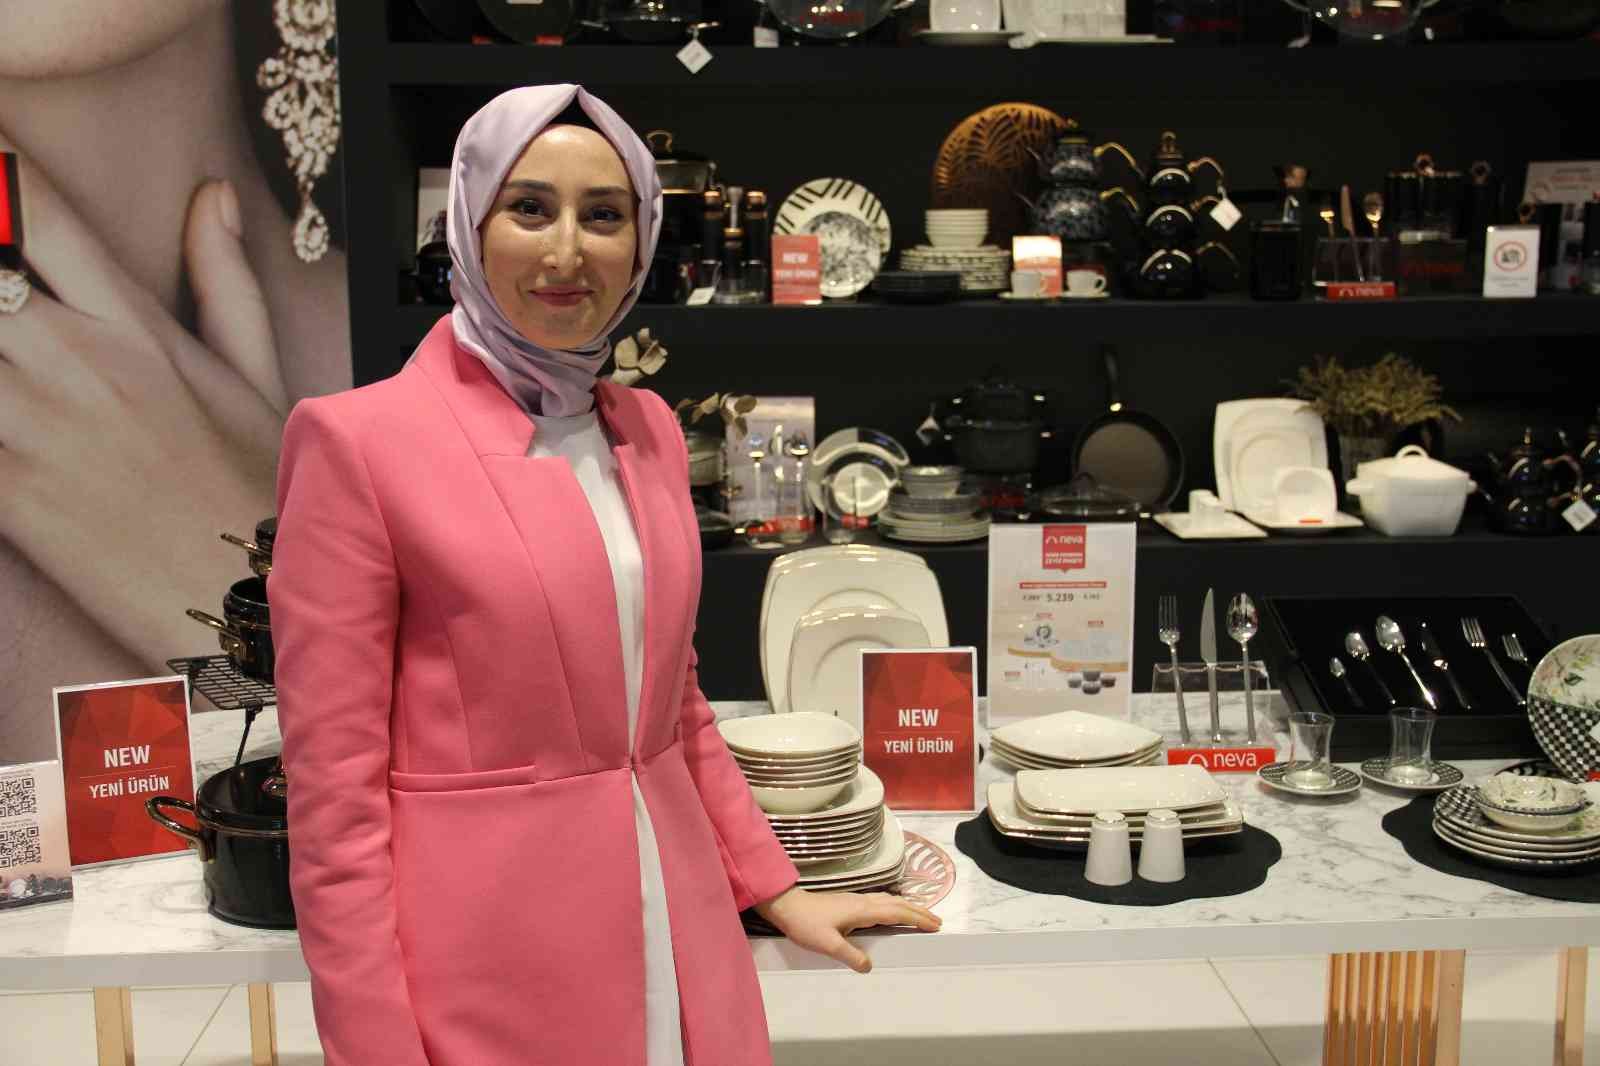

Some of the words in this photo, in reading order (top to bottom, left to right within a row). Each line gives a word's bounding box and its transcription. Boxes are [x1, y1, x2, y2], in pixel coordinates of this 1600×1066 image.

[898, 708, 939, 727] NEW
[884, 737, 913, 753] YENİ
[917, 736, 954, 753] ÜRÜN
[104, 744, 151, 768] NEW
[1213, 751, 1257, 767] neva
[89, 777, 124, 799] YENİ
[128, 774, 169, 794] ÜRÜN
